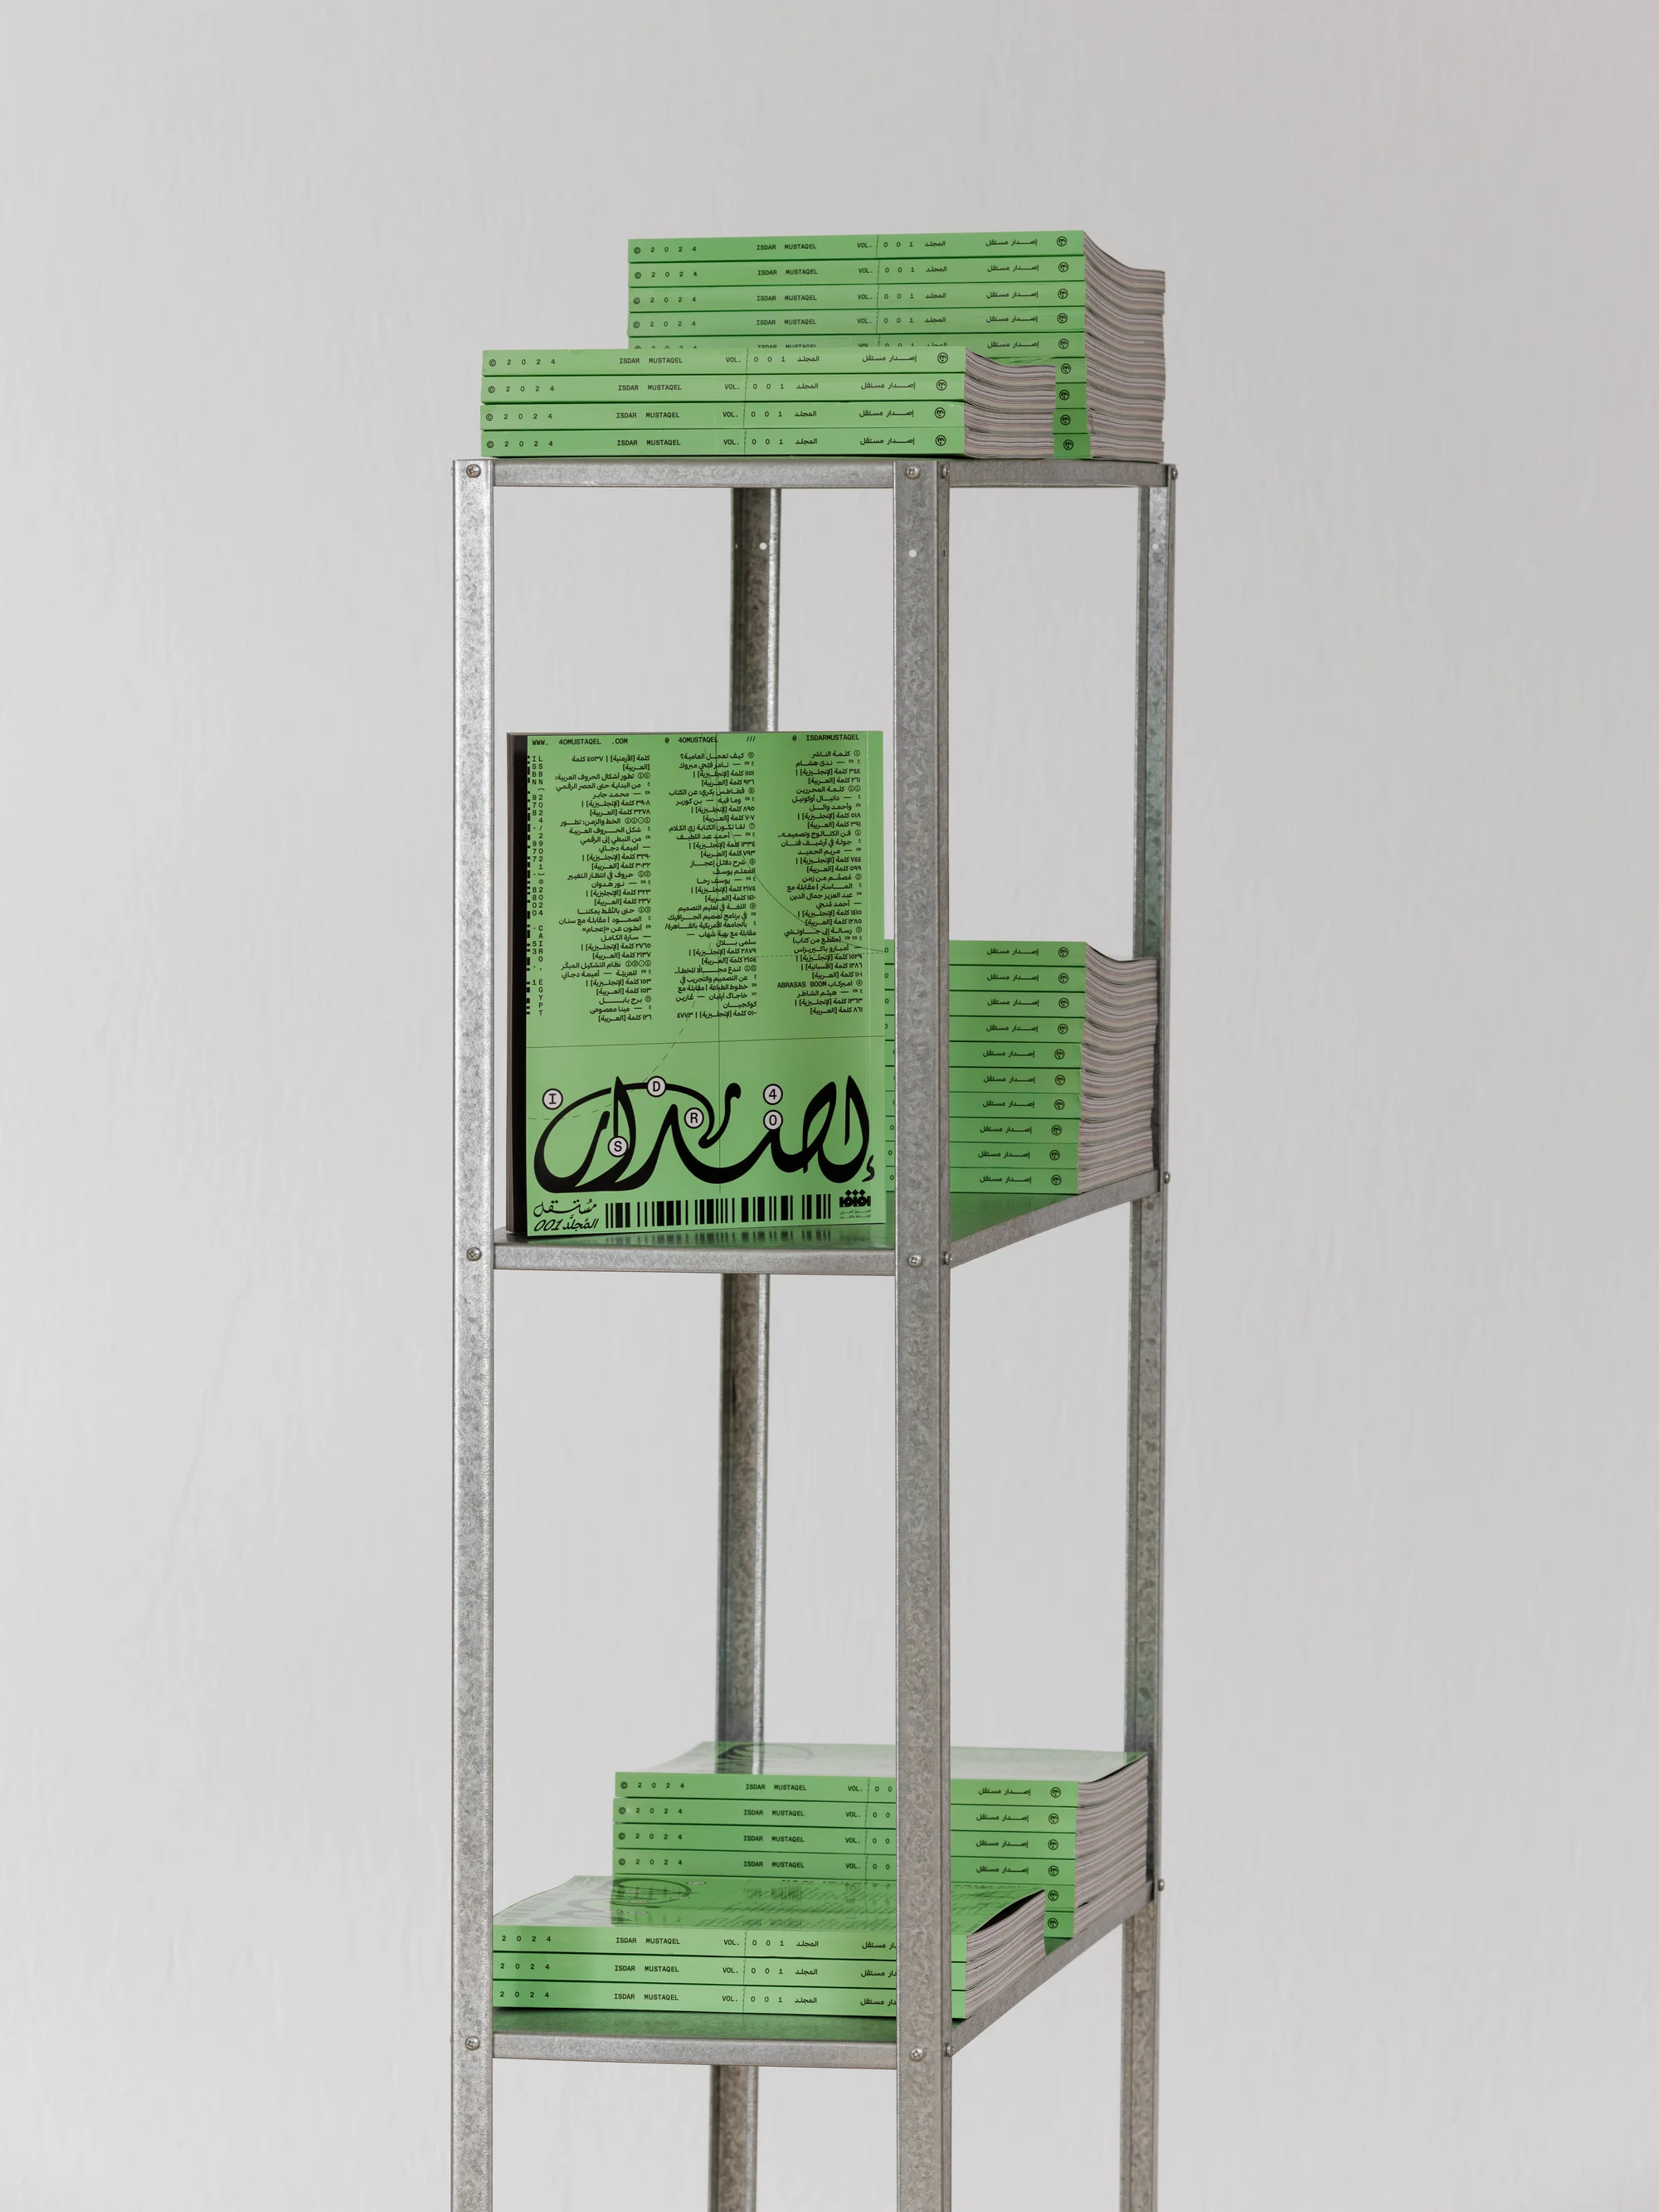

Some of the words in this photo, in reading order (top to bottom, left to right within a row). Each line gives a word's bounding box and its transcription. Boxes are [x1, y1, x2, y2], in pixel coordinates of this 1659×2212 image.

[862, 354, 886, 363] مستقل
[860, 437, 884, 446] مستقل
[860, 1998, 884, 2006] مستقل
